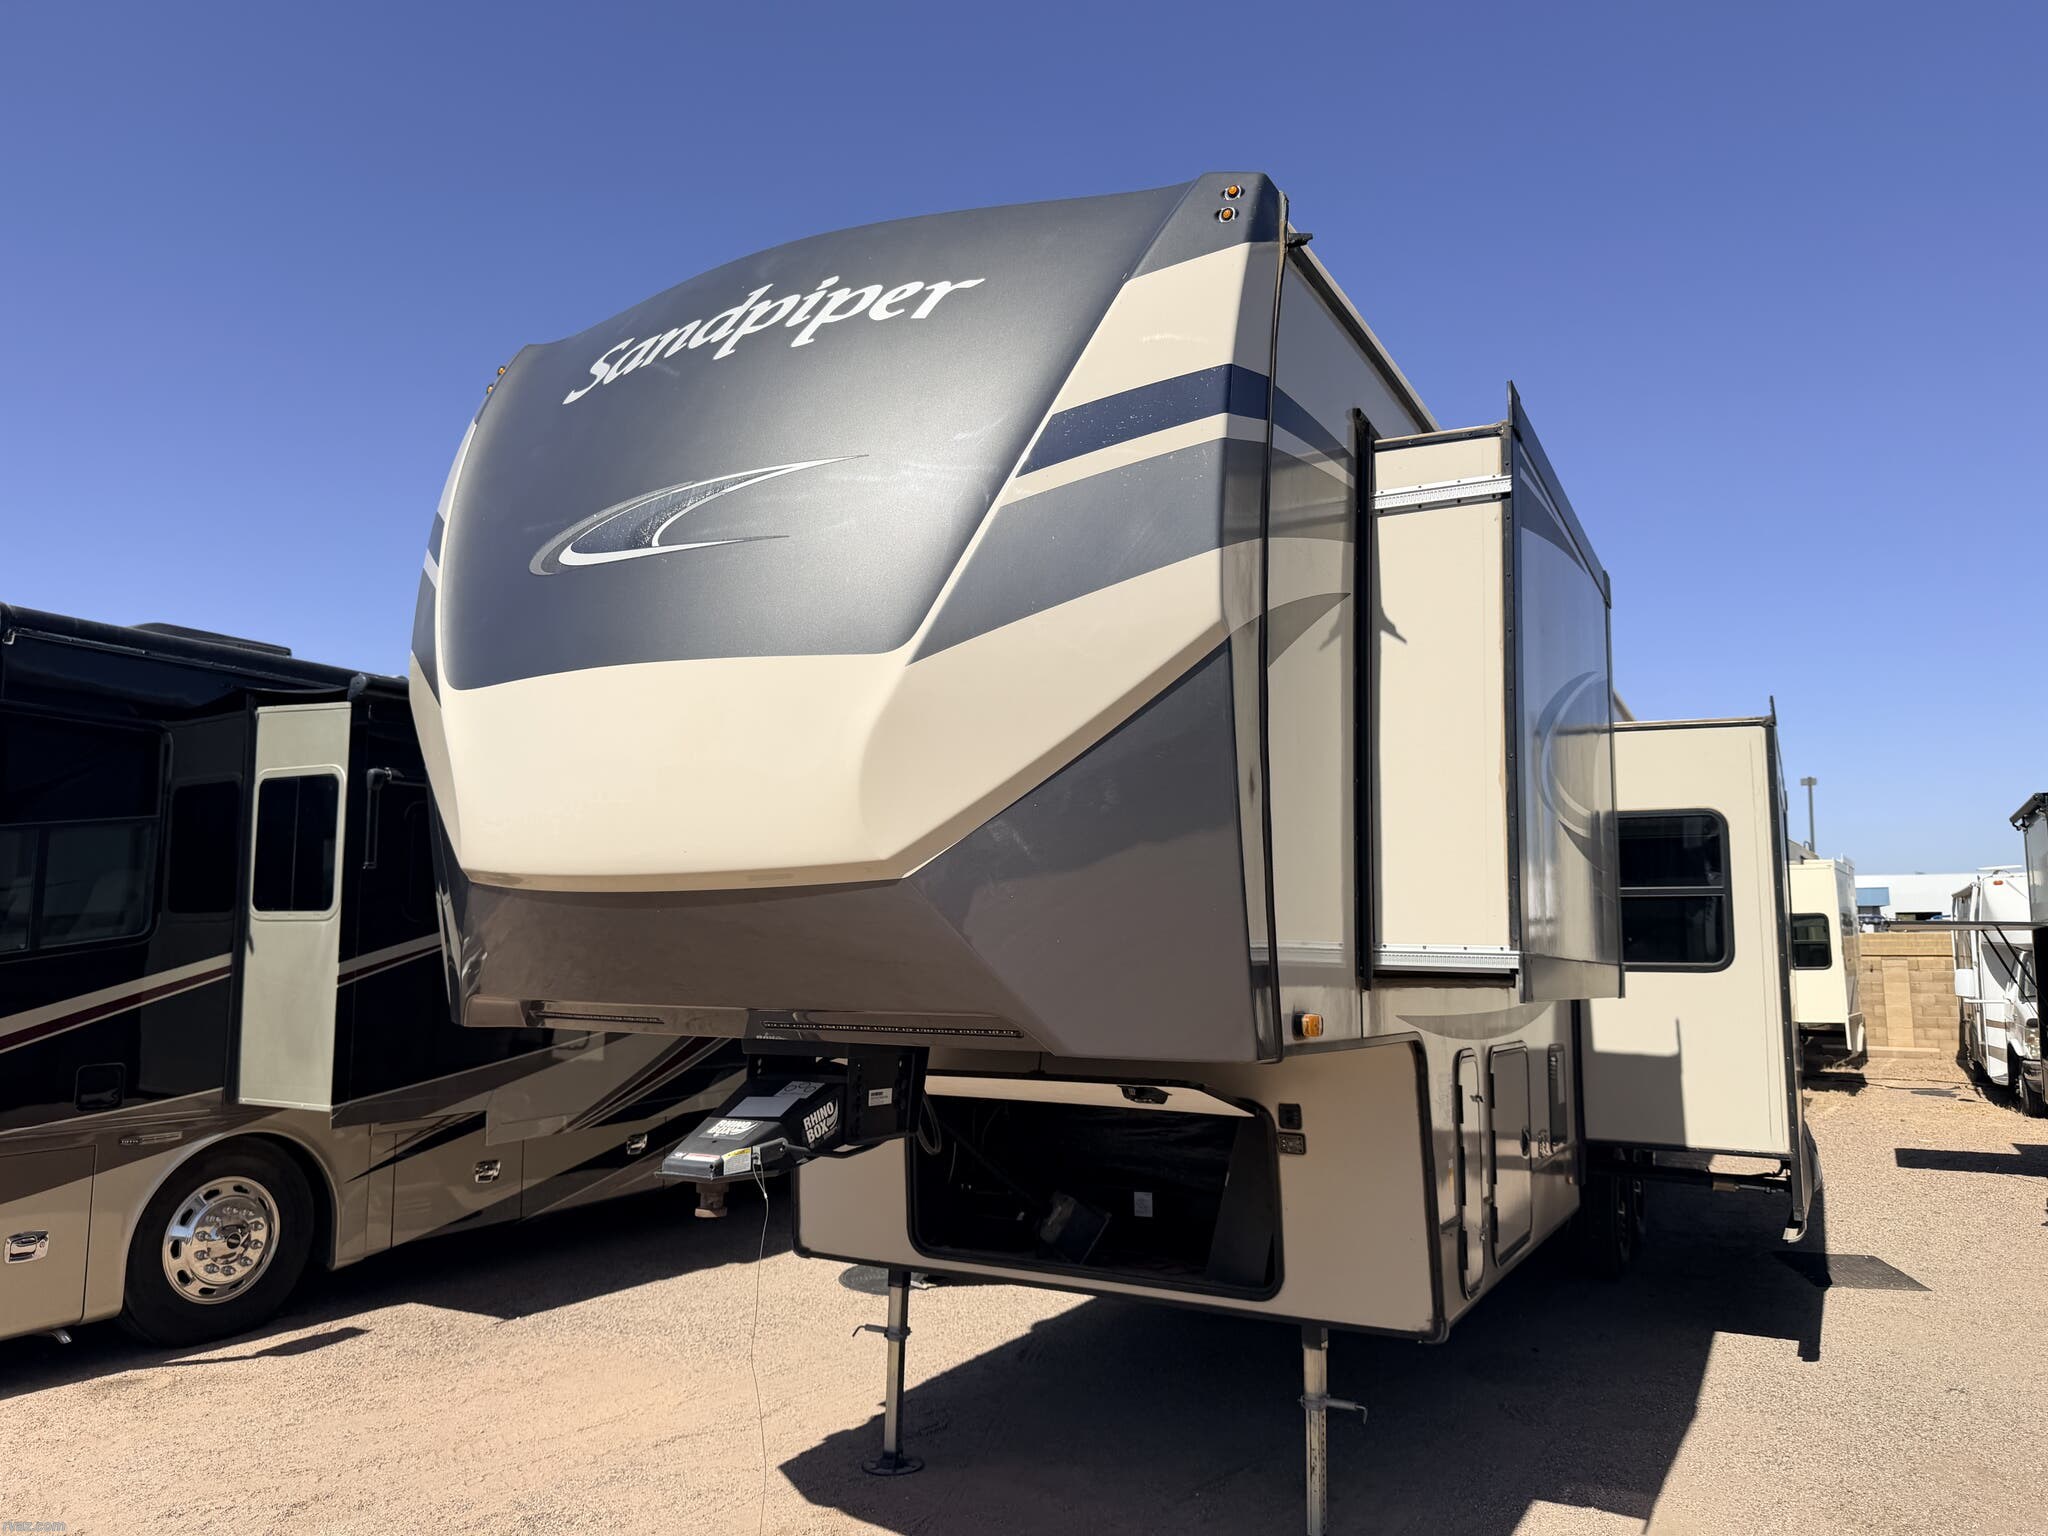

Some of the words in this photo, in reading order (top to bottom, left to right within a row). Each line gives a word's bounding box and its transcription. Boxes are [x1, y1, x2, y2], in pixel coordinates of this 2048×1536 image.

[563, 275, 986, 404] Sandpiper
[714, 1119, 752, 1129] RHINO
[803, 1101, 834, 1131] RHINO
[806, 1119, 829, 1144] BOX
